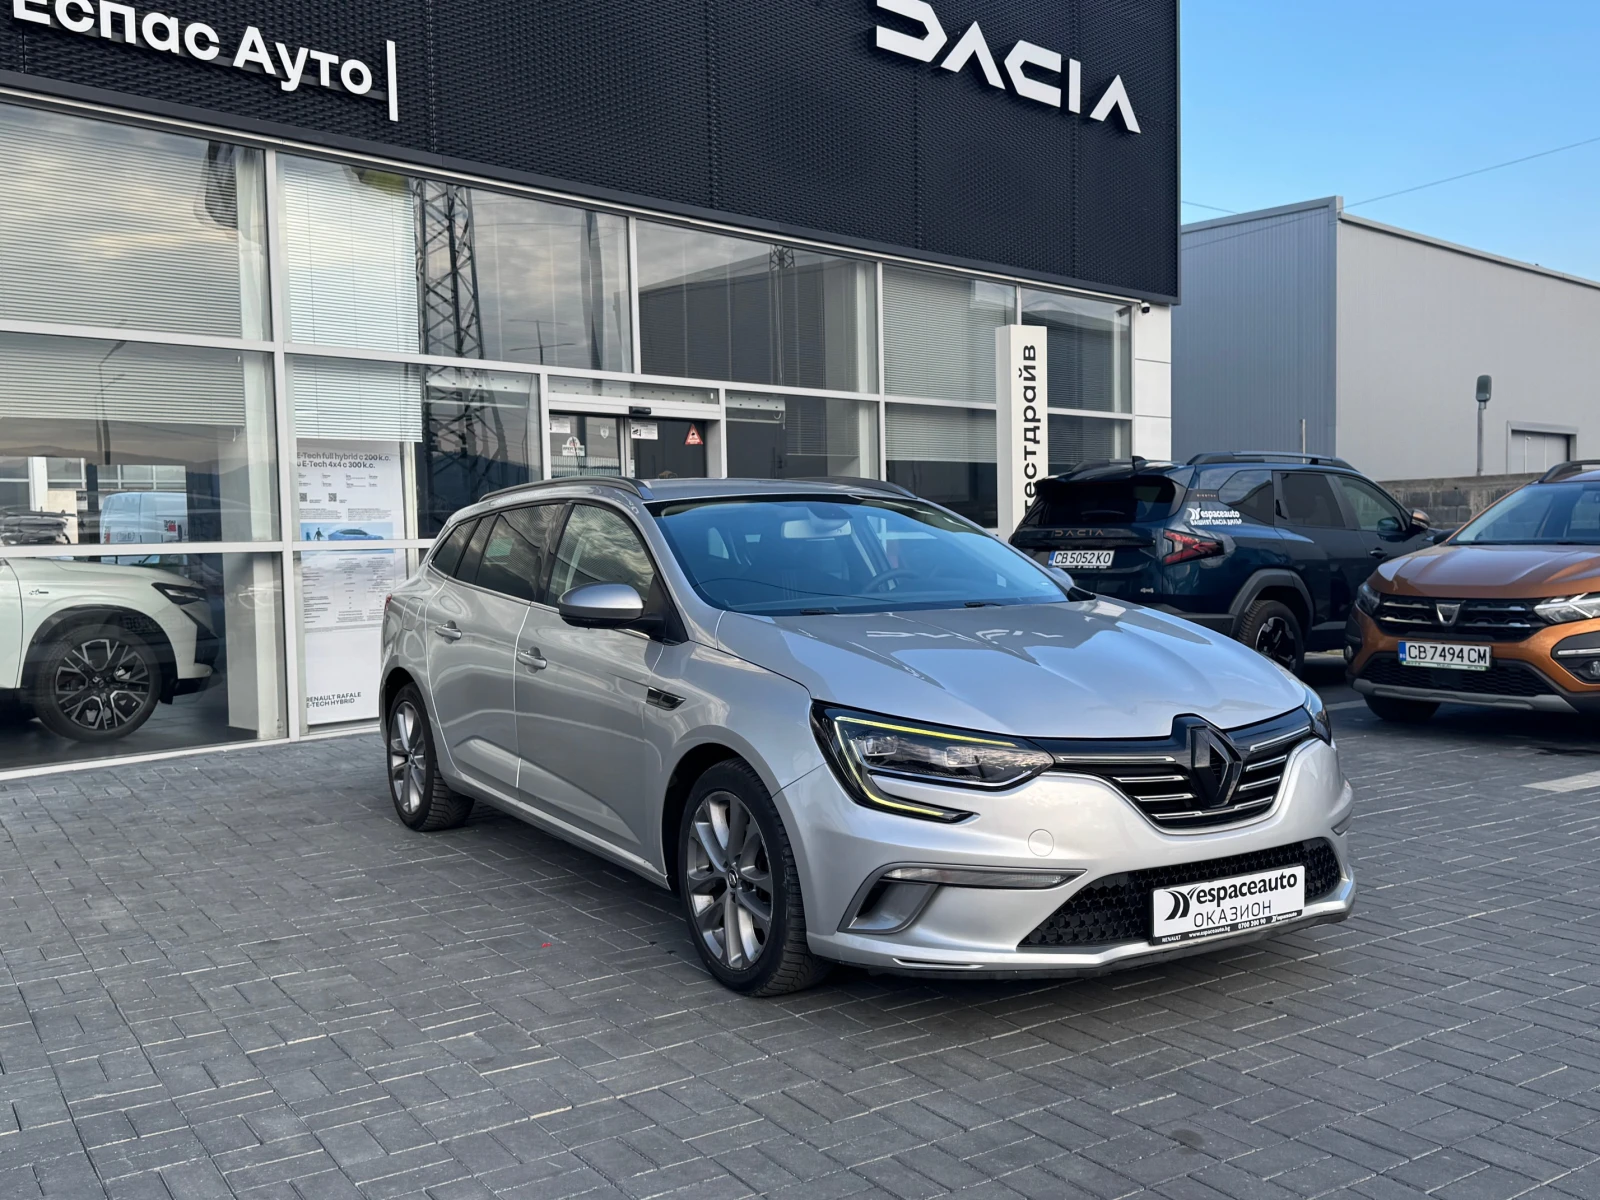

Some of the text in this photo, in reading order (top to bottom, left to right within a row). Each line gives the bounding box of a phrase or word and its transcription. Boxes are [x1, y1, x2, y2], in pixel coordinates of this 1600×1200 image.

[233, 26, 373, 95] Ауто
[876, 0, 1141, 134] DACIA
[322, 452, 334, 460] full
[335, 453, 358, 462] hybrid
[1055, 529, 1105, 537] DACIA
[1070, 552, 1096, 564] 5052
[1429, 646, 1465, 662] 7494
[306, 694, 336, 702] RENAULT
[330, 698, 355, 706] HYBRID
[1196, 872, 1298, 907] espaceauto
[1193, 900, 1272, 928] ОКАЗИОН
